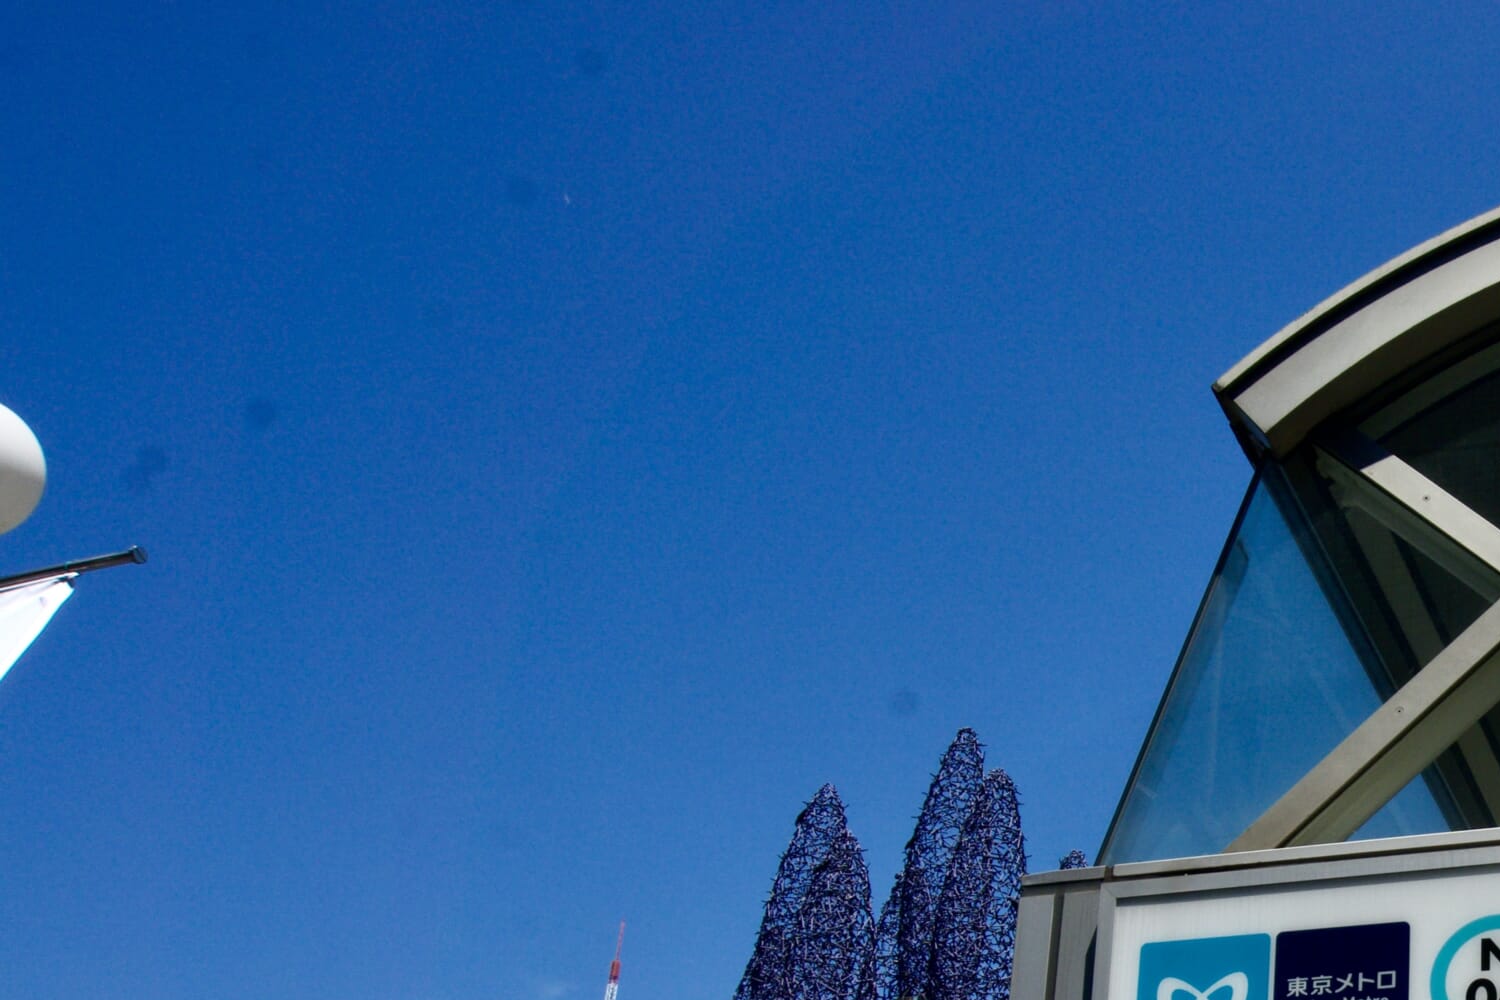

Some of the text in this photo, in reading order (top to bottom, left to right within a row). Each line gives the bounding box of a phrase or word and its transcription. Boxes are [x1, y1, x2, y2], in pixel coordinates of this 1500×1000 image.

[1286, 969, 1397, 998] 東京メトロ
